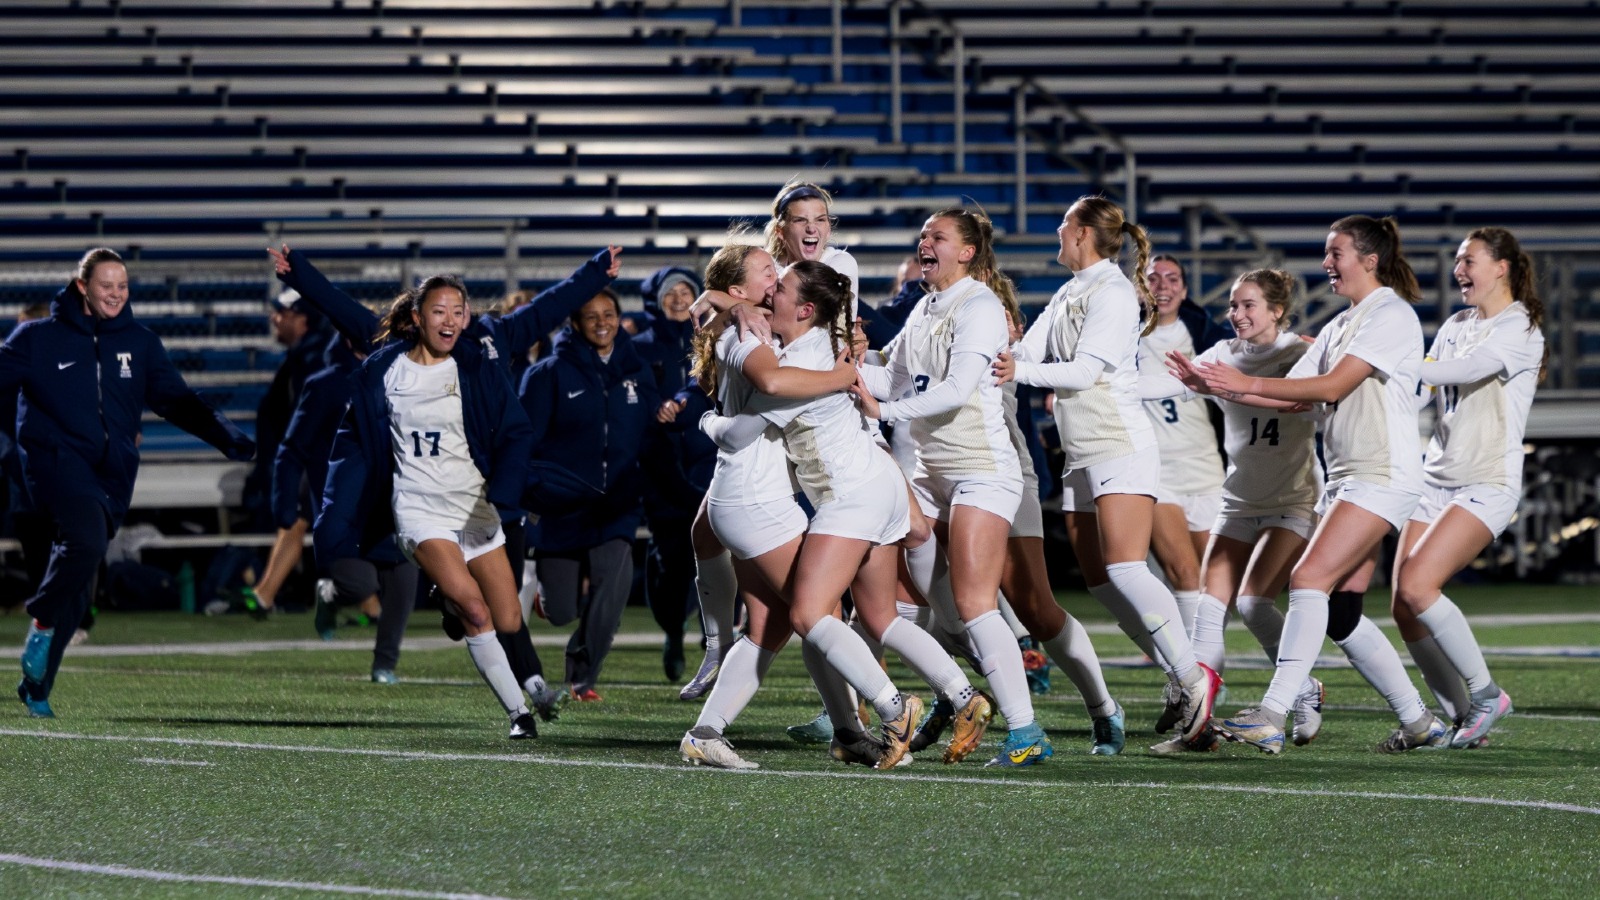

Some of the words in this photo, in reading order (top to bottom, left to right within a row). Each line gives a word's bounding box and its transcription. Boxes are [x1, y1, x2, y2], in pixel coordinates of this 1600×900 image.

[117, 353, 131, 370] T
[1161, 399, 1178, 423] 3
[411, 431, 441, 457] 17
[1249, 417, 1279, 446] 14
